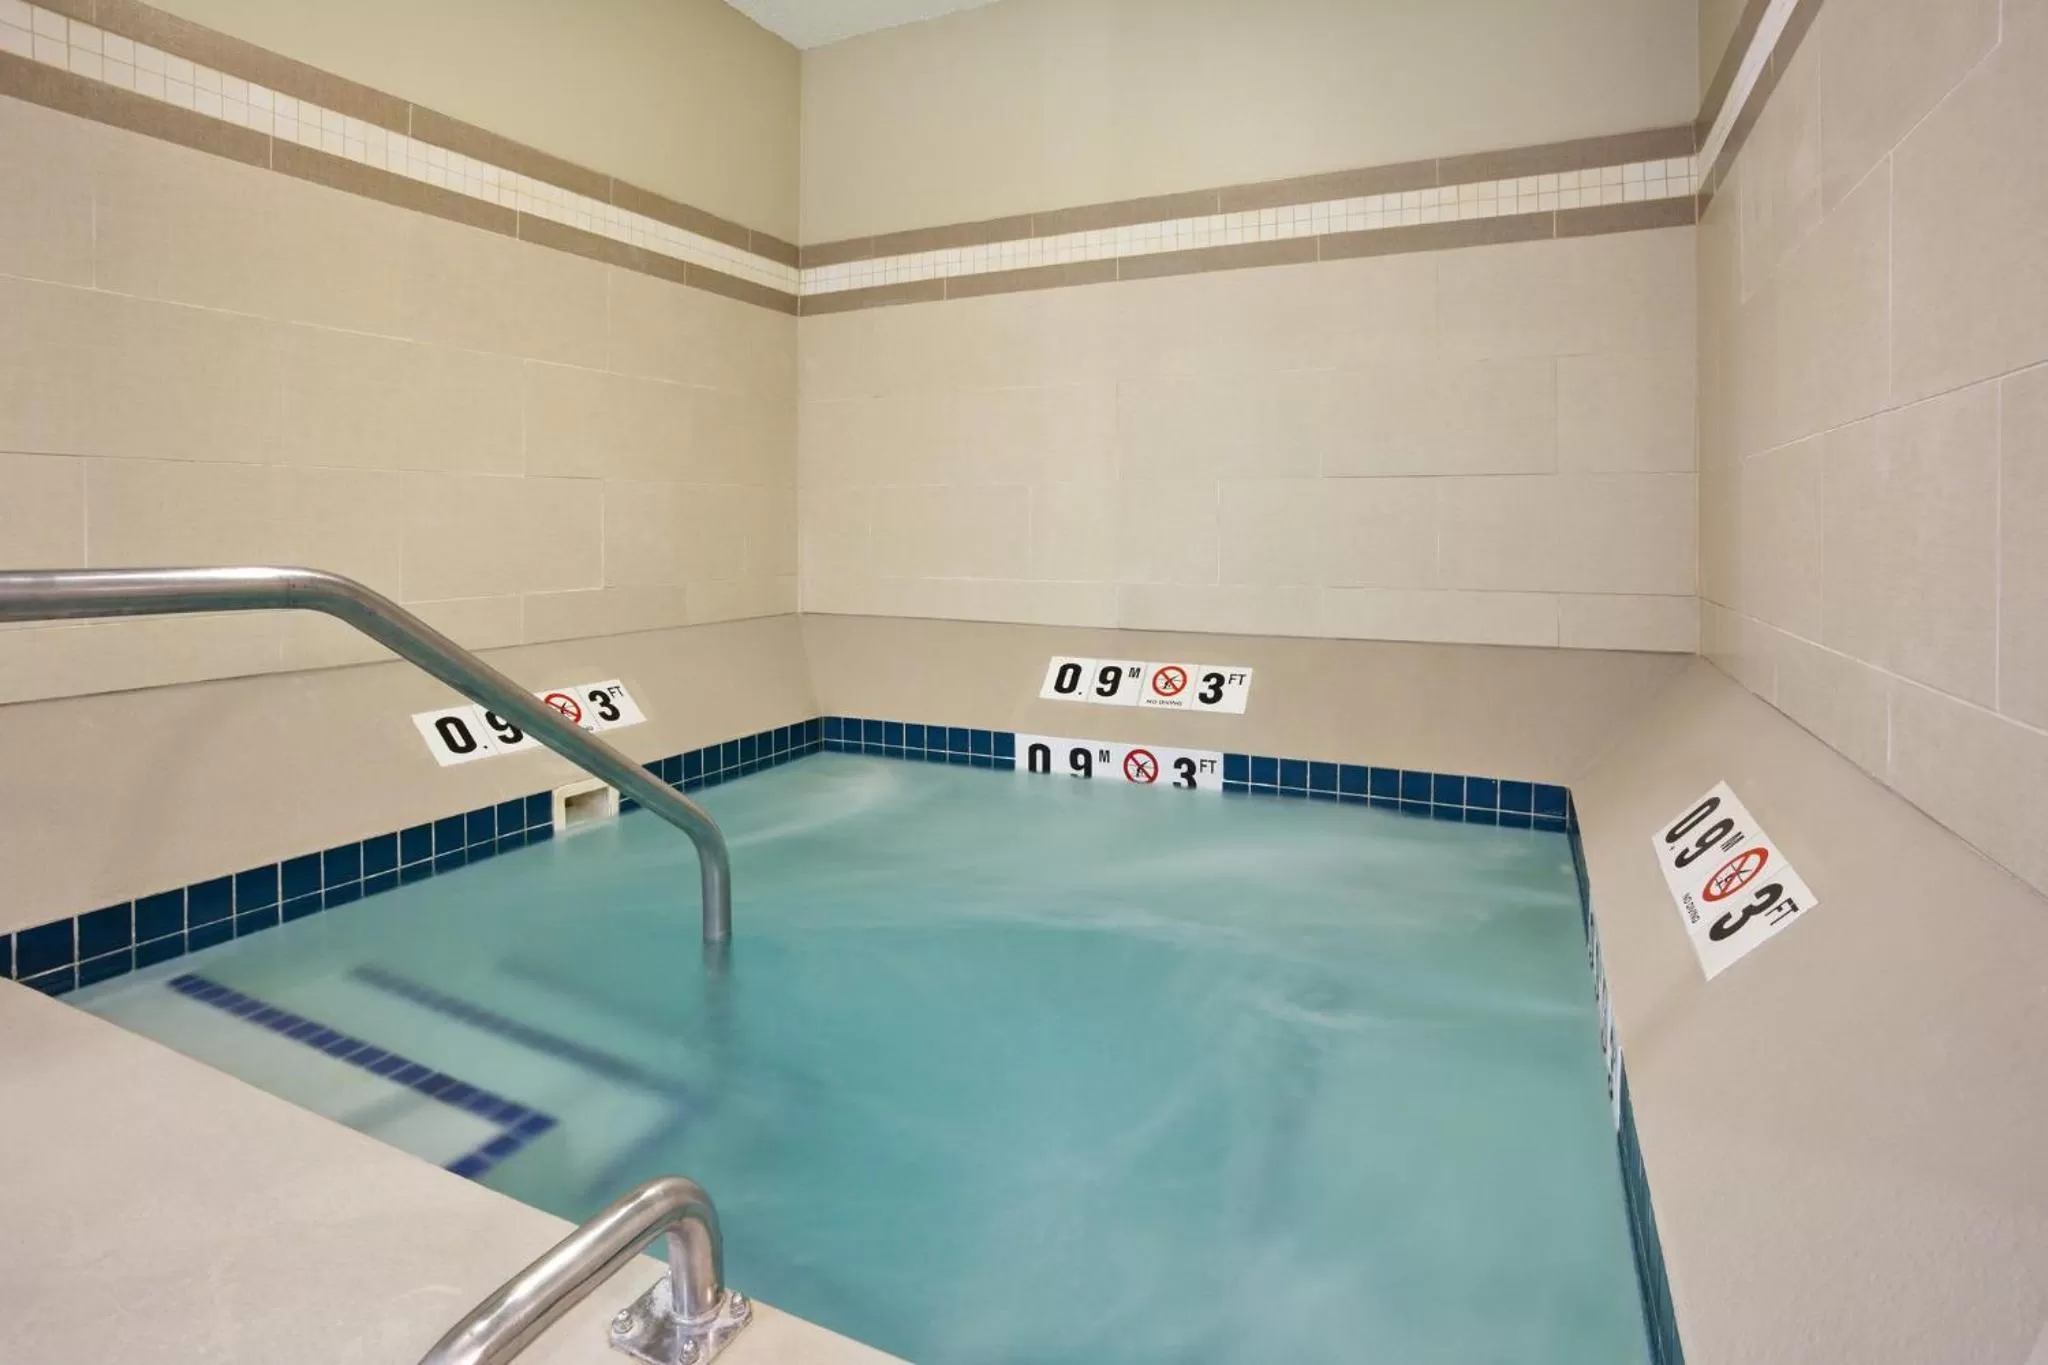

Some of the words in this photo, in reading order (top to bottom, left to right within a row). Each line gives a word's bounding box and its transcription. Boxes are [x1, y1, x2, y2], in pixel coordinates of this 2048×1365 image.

[588, 689, 621, 722] 3
[609, 685, 625, 699] FT
[1128, 667, 1141, 679] M
[1198, 672, 1225, 705] 3
[1228, 674, 1247, 686] FT
[1098, 749, 1111, 763] M
[1173, 757, 1197, 790] 3
[1200, 759, 1217, 775] FT
[1720, 831, 1745, 853] M
[1708, 883, 1784, 942] 3
[1764, 897, 1800, 927] FT
